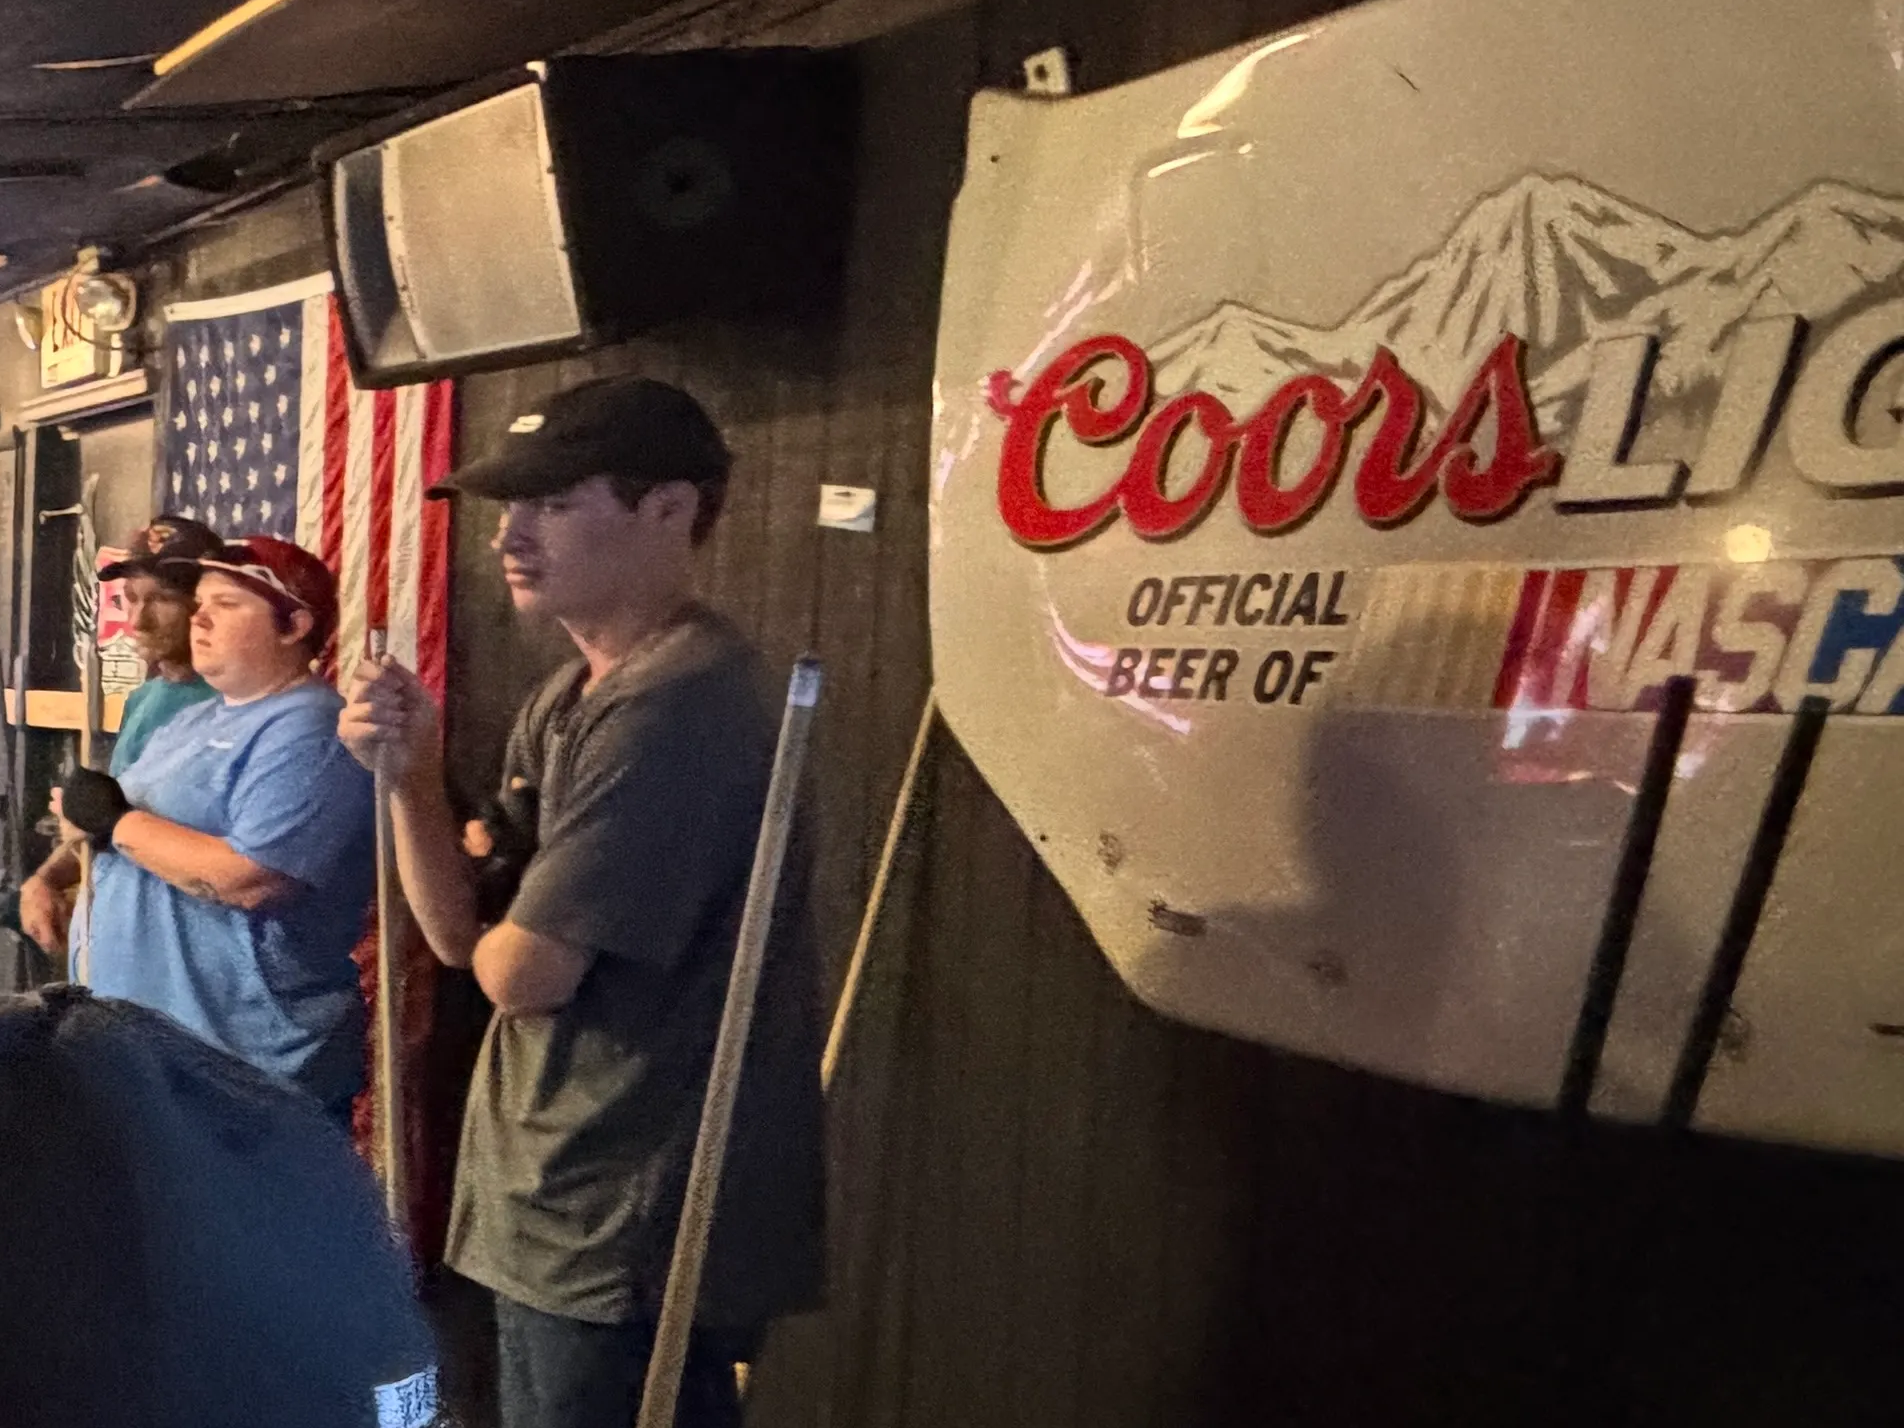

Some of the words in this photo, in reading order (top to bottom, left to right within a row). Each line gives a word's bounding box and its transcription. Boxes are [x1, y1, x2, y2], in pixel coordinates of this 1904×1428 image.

[985, 329, 1566, 550] Coors
[1126, 570, 1350, 627] OFFICIAL
[1104, 647, 1240, 702] BEER
[1252, 650, 1339, 706] OF
